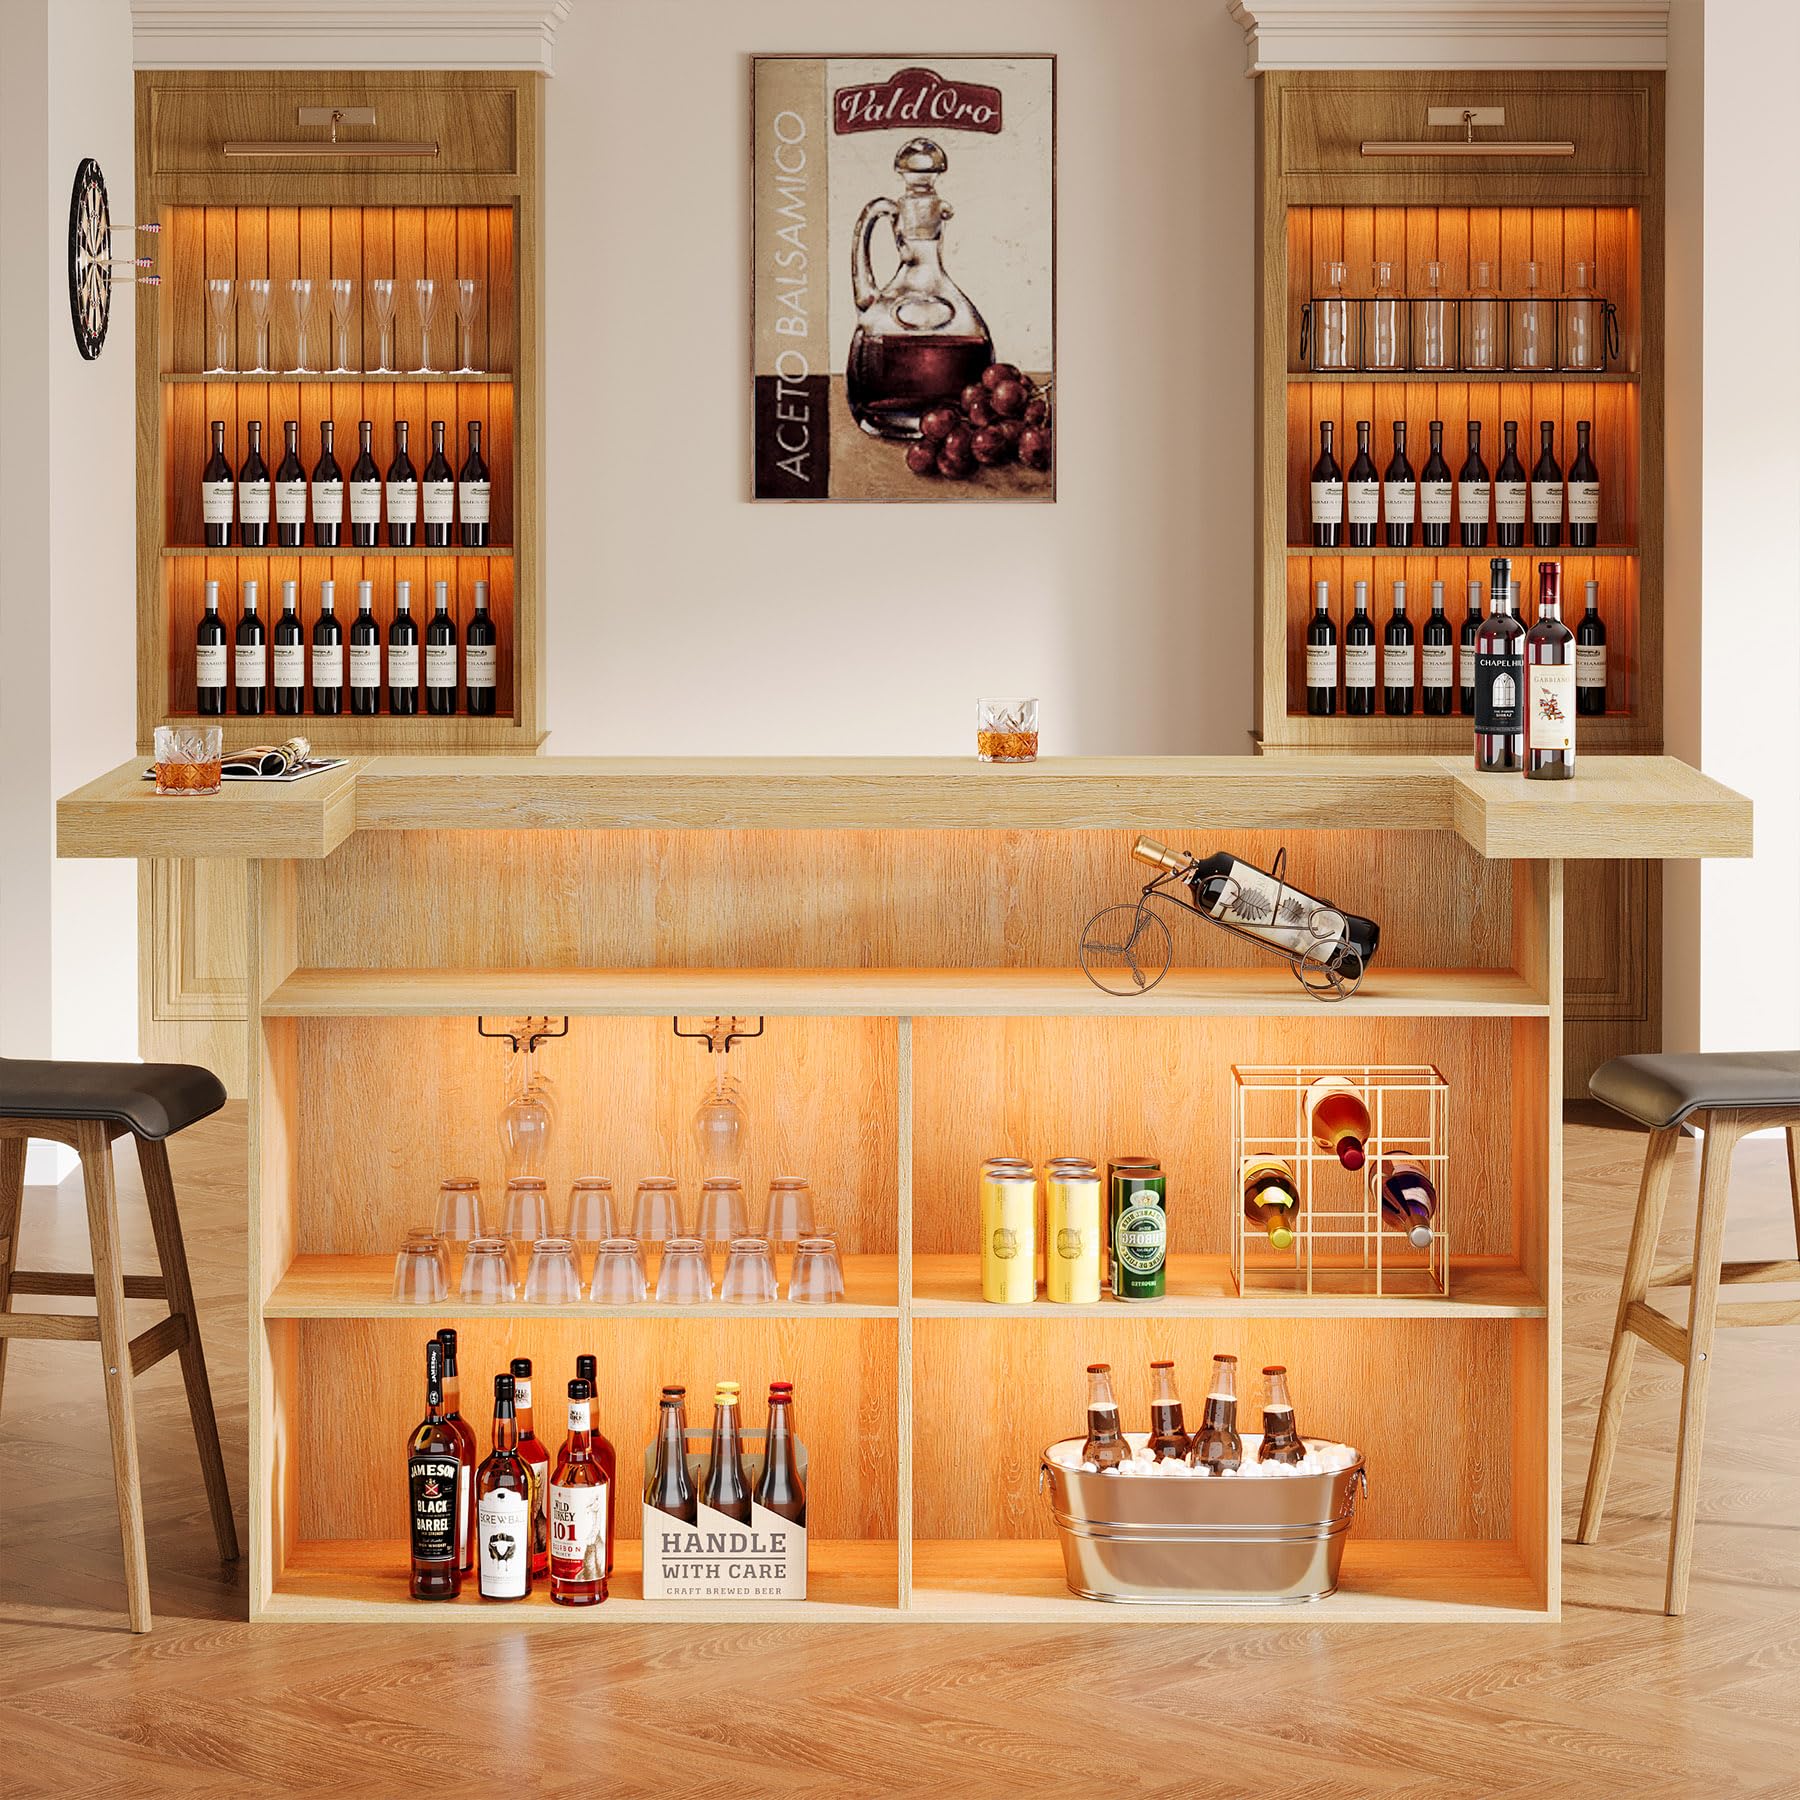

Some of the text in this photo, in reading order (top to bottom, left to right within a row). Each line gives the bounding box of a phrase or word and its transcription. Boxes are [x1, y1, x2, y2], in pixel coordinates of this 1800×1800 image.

[773, 110, 810, 482] ACETO BALSAMICO
[1480, 659, 1511, 667] CHAPEL
[411, 1464, 455, 1479] JAMESON
[417, 1500, 448, 1513] BLACK
[416, 1518, 448, 1532] BARREL
[554, 1522, 576, 1541] 101
[662, 1533, 786, 1553] HANDLE
[662, 1564, 786, 1579] WITH CARE
